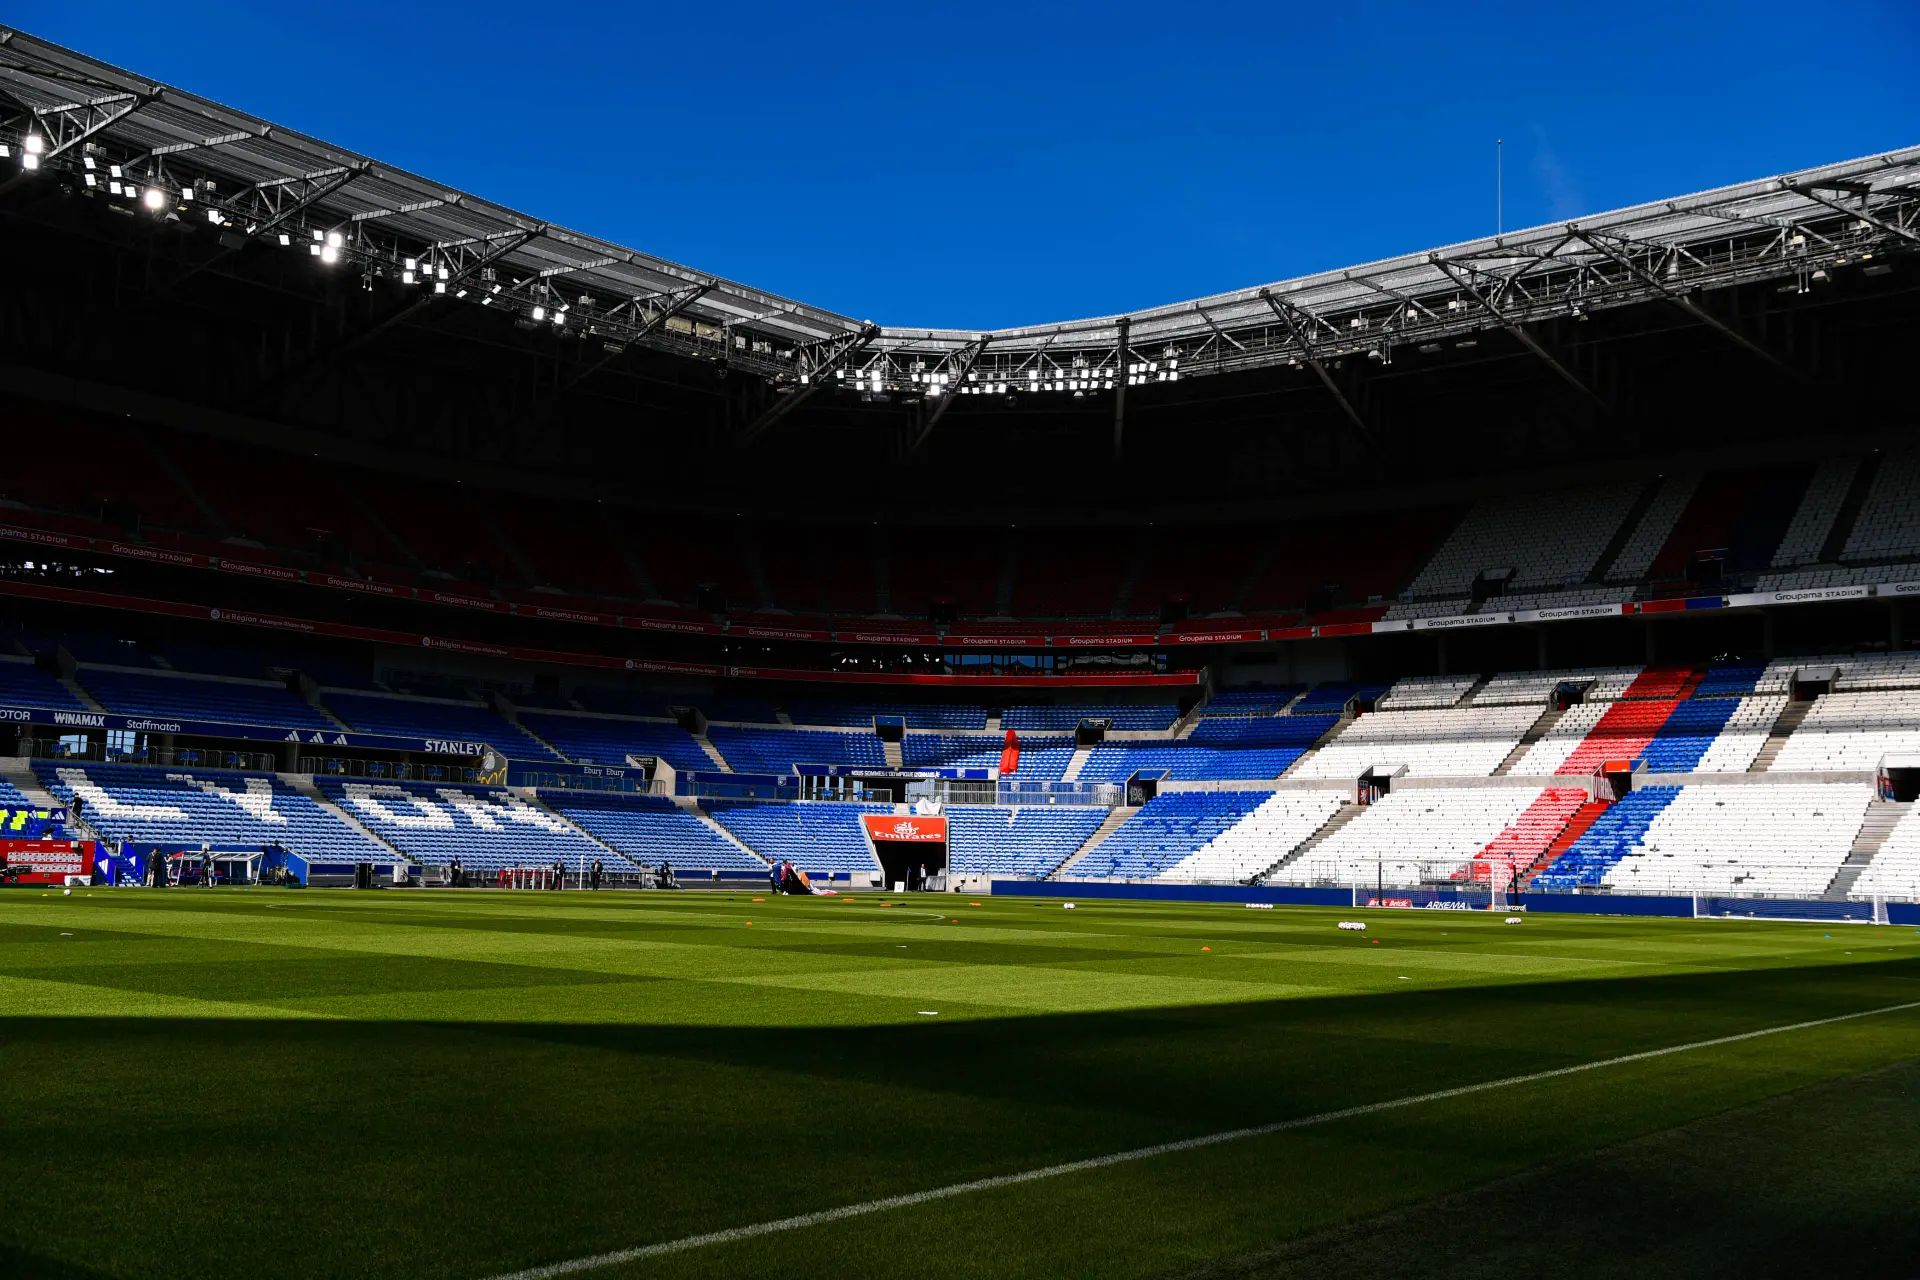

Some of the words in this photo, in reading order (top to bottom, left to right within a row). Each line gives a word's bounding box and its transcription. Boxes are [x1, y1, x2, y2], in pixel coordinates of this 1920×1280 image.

[0, 528, 28, 538] pama
[30, 533, 67, 544] STADIUM
[112, 544, 157, 558] Groupama
[159, 552, 193, 563] STADIUM
[220, 560, 262, 574] Groupama
[263, 567, 294, 579] STADIUM
[327, 577, 364, 589] Groupama
[365, 584, 394, 594] STADIUM
[1775, 592, 1822, 601] Groupama
[1826, 589, 1863, 597] STADIUM
[434, 594, 468, 605] Groupama
[469, 599, 495, 609] STADIUM
[232, 613, 257, 623] Région
[537, 608, 571, 619] Groupama
[572, 613, 599, 622] STADIUM
[1539, 609, 1580, 619] Groupama
[1581, 607, 1613, 615] STADIUM
[641, 620, 676, 630] Groupama
[677, 624, 704, 632] STADIUM
[1428, 619, 1465, 628] Groupama
[1466, 616, 1496, 624] STADIUM
[748, 629, 783, 638] Groupama
[856, 634, 891, 643] Groupama
[1179, 635, 1213, 643] Groupama
[440, 640, 461, 649] Région
[963, 637, 998, 645] Groupama
[1070, 637, 1105, 645] Groupama
[643, 662, 666, 671] Région
[0, 709, 31, 721] OTOR
[54, 712, 105, 727] WINAMAX
[126, 719, 181, 732] Staffmatch
[424, 740, 483, 755] STANLEY
[583, 766, 603, 777] Ebury
[605, 768, 625, 778] Ebury
[873, 830, 942, 840] Emirates
[1425, 901, 1466, 910] ARKEMA
